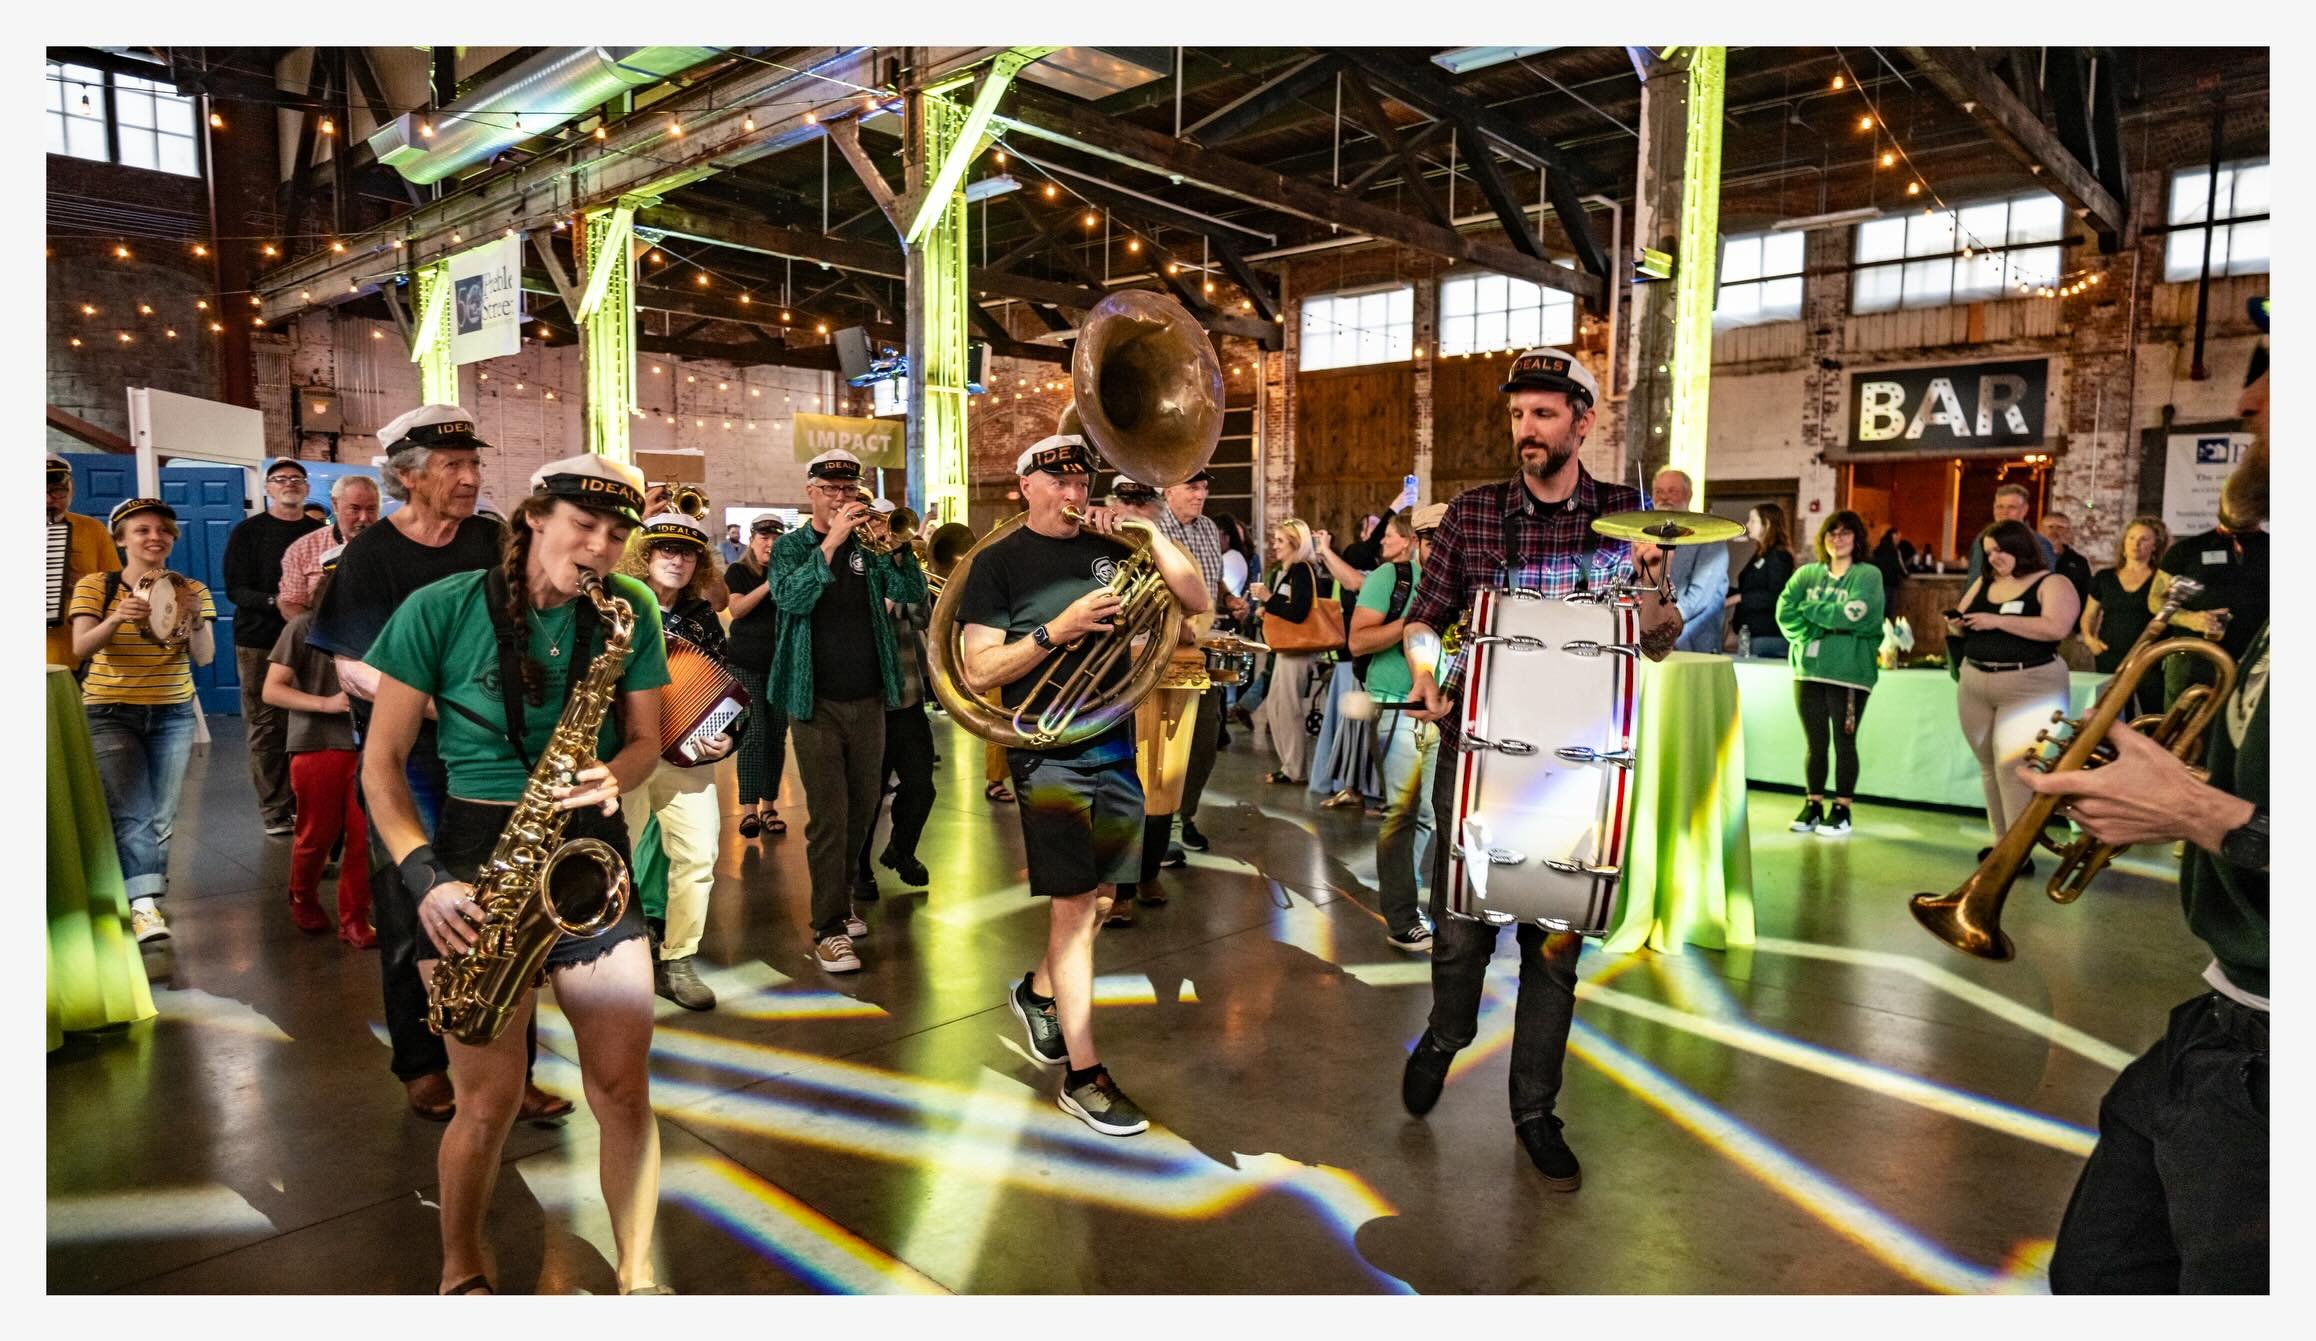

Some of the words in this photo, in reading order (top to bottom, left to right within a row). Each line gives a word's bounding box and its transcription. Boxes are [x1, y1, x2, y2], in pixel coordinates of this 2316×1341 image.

[1859, 374, 2031, 441] BAR
[807, 430, 892, 453] IMPACT
[825, 461, 857, 471] IDEALS
[581, 478, 643, 505] IDEALS
[657, 525, 699, 538] IDEALS
